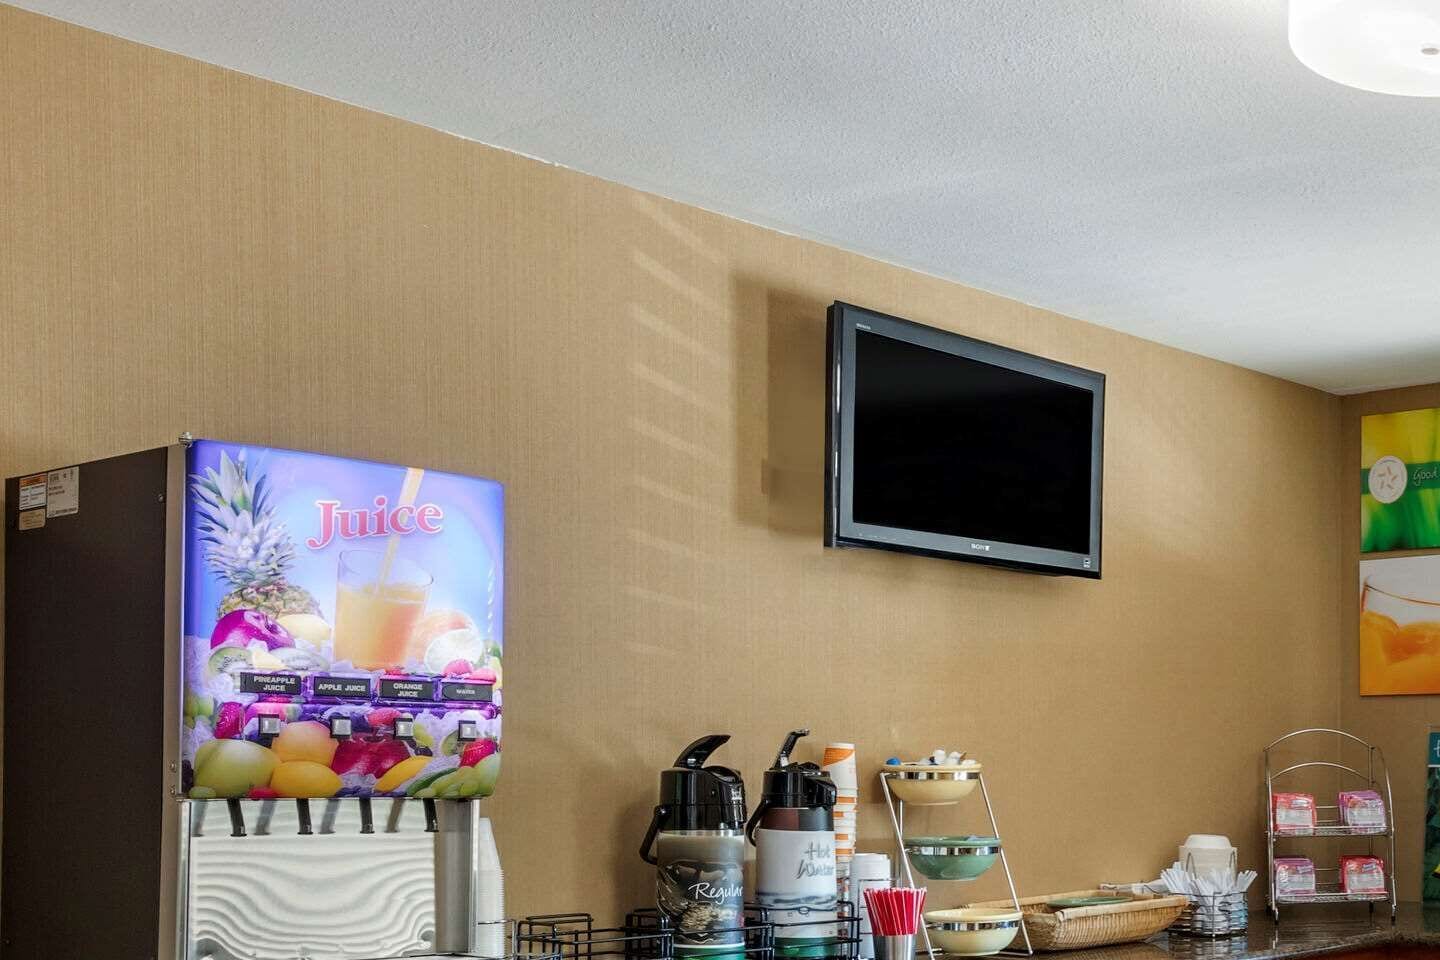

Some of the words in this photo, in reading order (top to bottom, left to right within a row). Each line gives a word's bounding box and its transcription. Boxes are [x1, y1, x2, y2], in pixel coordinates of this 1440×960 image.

[1413, 466, 1438, 487] Good
[307, 497, 442, 549] Juice
[253, 675, 296, 685] PINEAPPLE
[262, 683, 286, 692] JUICE
[318, 683, 342, 692] APPLE
[344, 684, 367, 692] JUICE
[393, 682, 423, 691] ORANGE
[397, 689, 419, 698] JUICE
[688, 881, 744, 905] Regular
